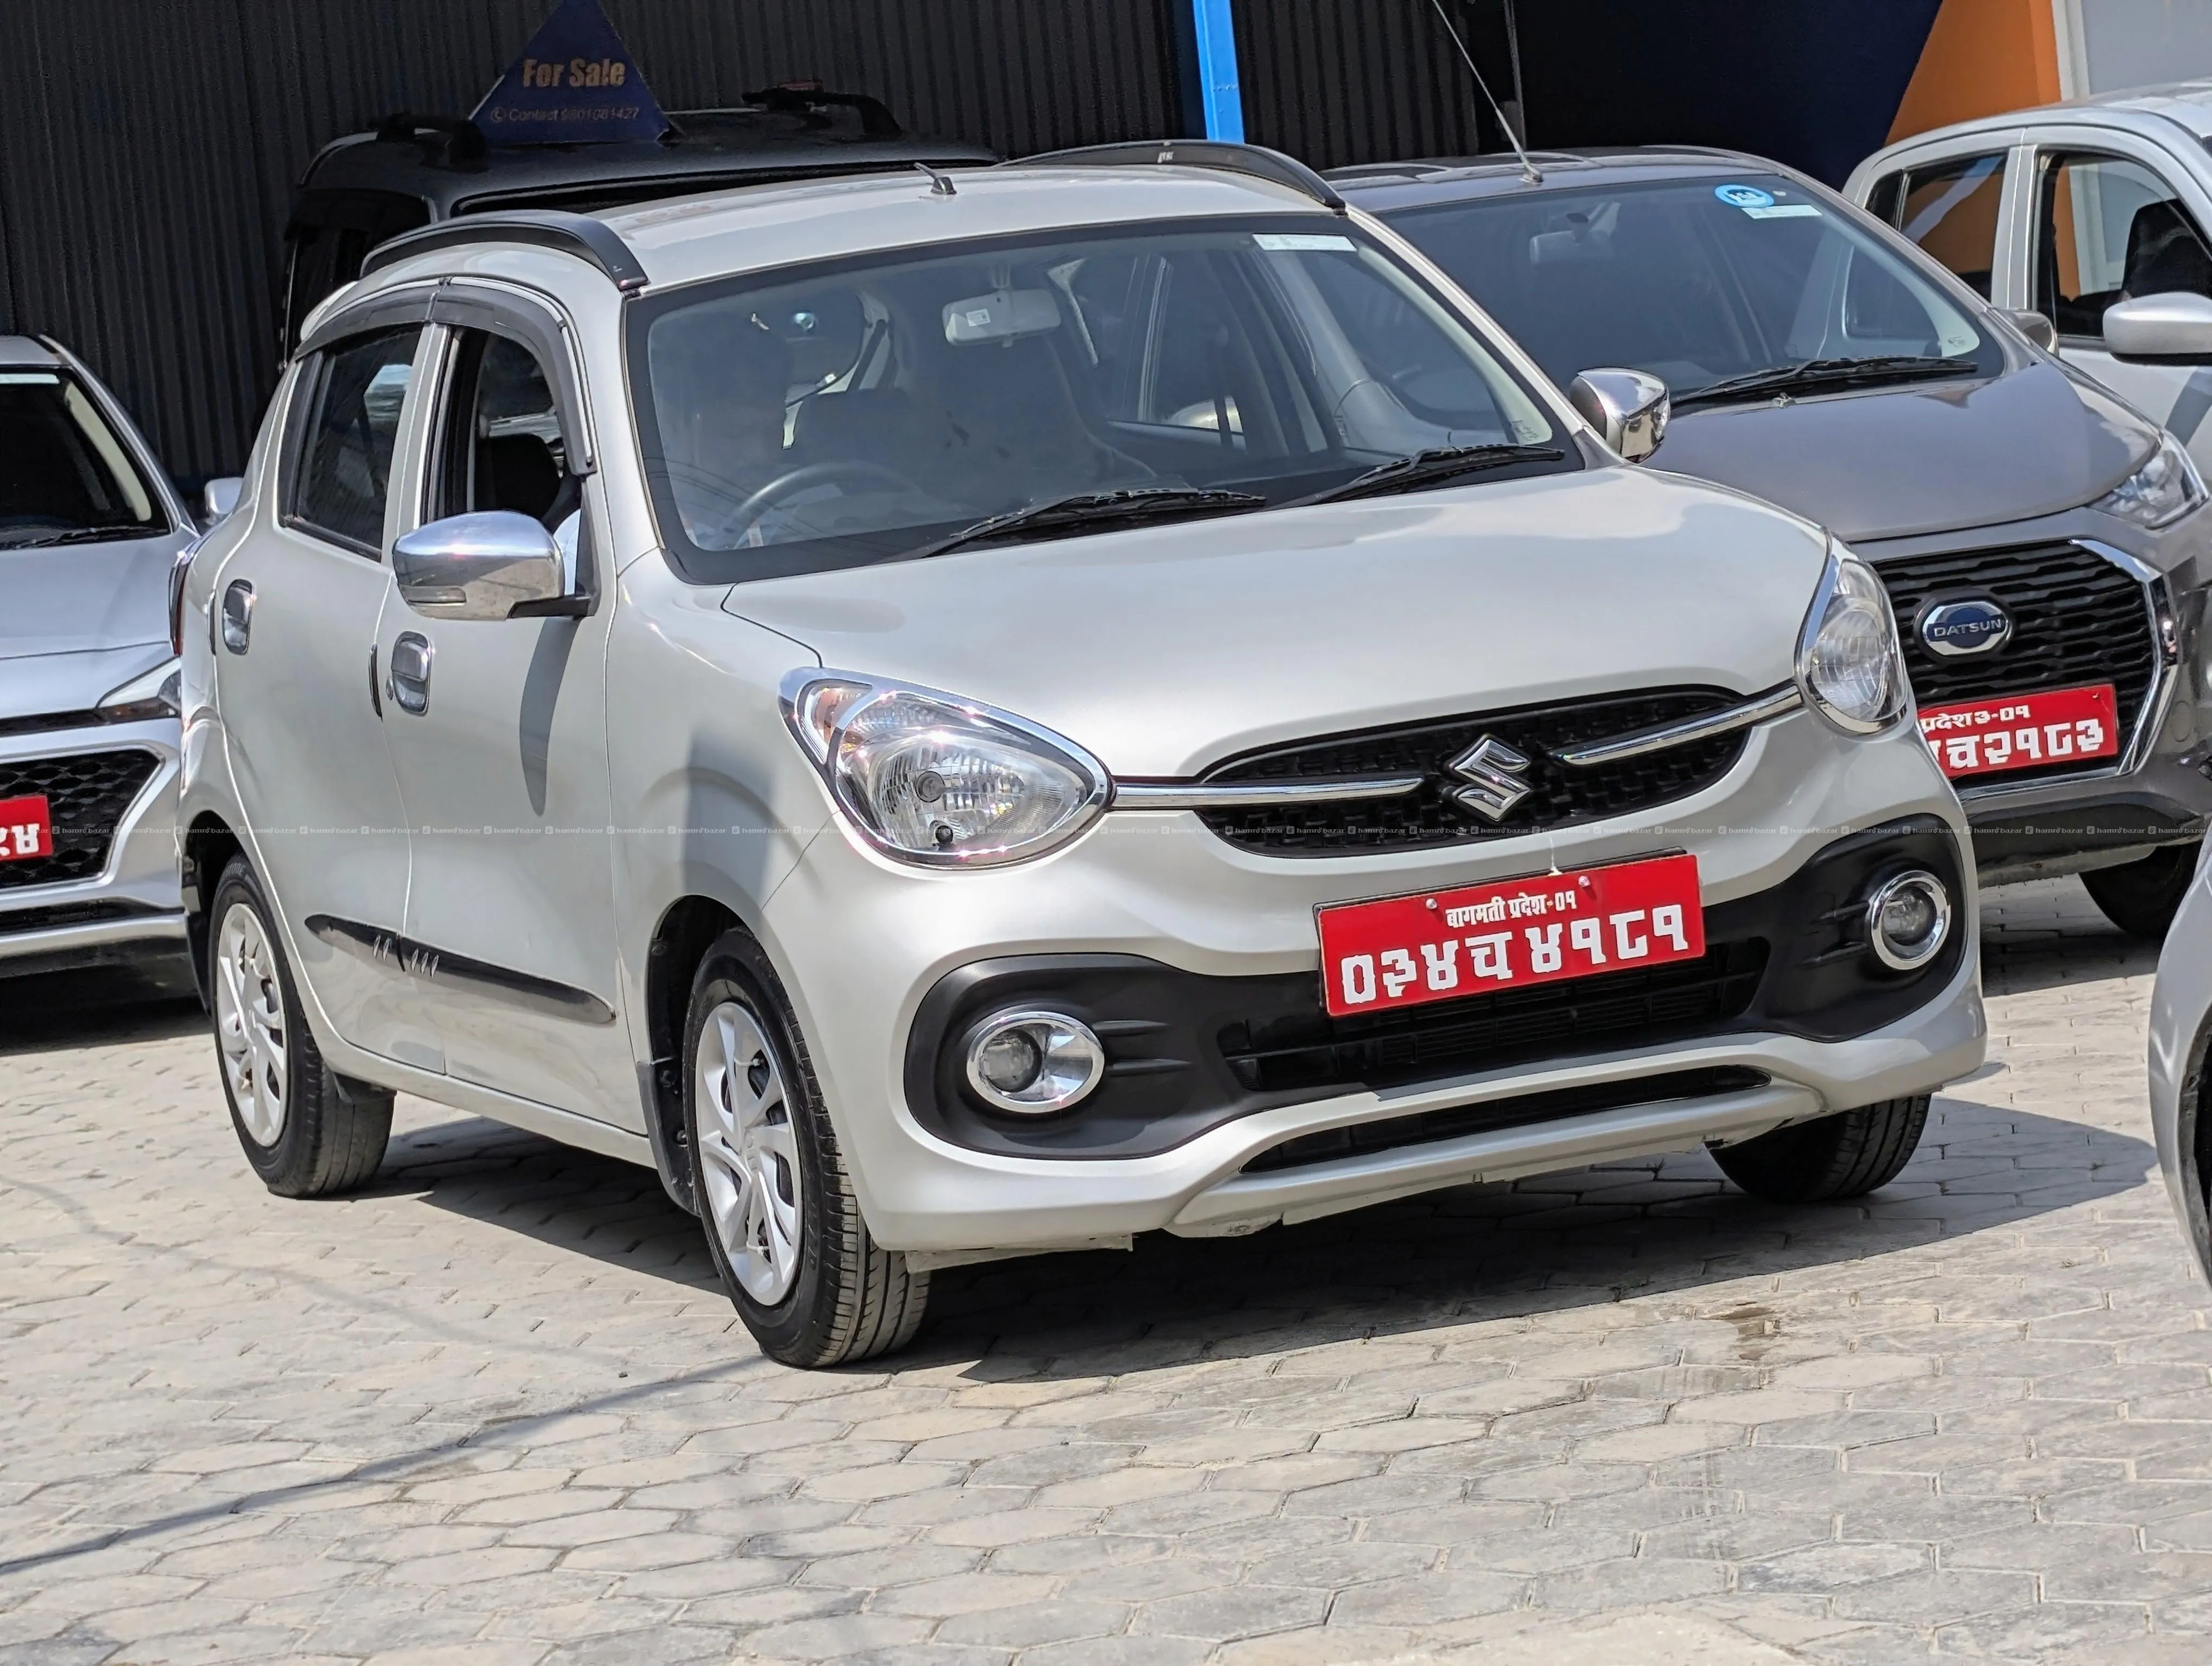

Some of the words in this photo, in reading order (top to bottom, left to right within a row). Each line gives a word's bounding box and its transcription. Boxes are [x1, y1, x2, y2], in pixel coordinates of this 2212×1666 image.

[523, 58, 564, 87] For
[569, 57, 625, 87] Sale
[508, 108, 558, 121] Contact
[1934, 618, 2002, 637] DATSUN
[1445, 896, 1506, 928] बागमती
